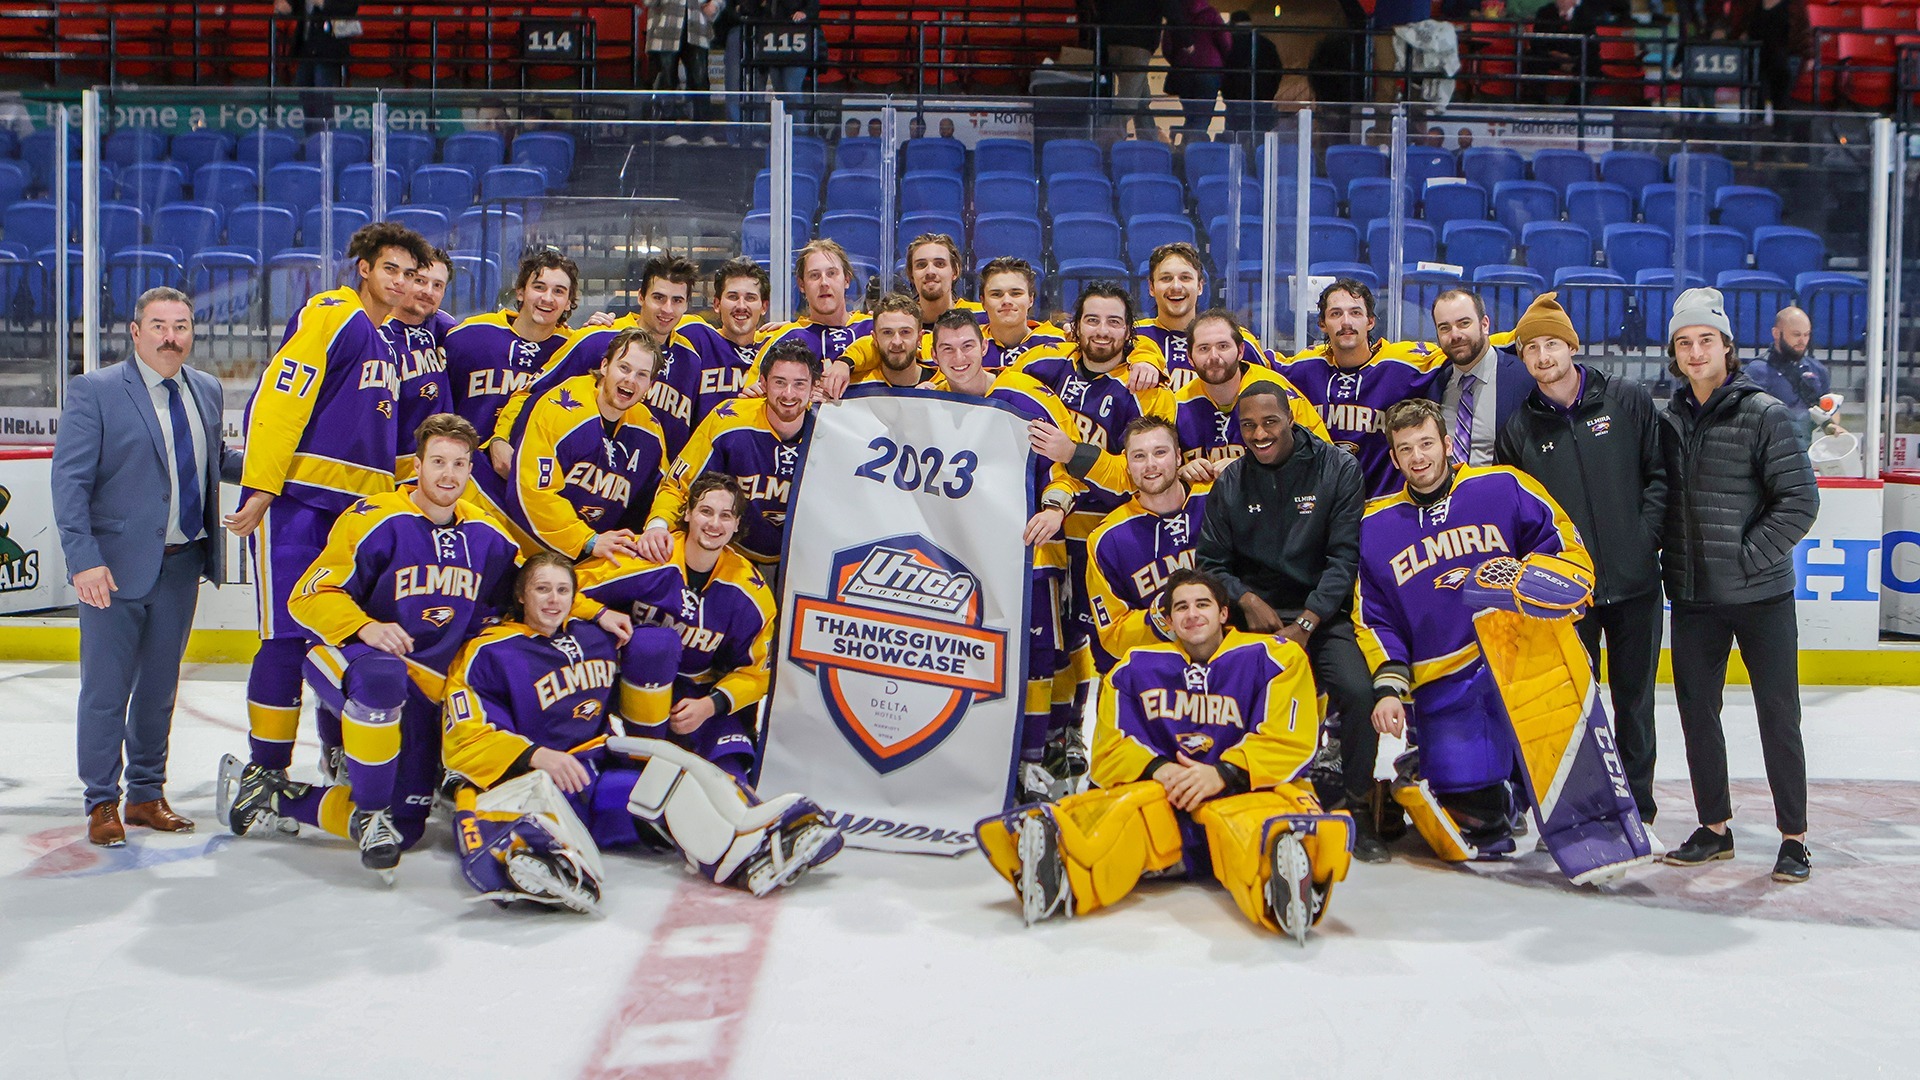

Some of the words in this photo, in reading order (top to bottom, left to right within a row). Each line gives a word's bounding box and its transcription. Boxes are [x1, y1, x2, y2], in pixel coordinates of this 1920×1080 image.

[527, 31, 572, 51] 114
[763, 32, 806, 52] 115
[1694, 54, 1738, 74] 115
[219, 103, 305, 128] Foste
[274, 357, 320, 398] 27
[467, 368, 533, 398] ELM
[641, 380, 692, 428] MIRA
[1099, 394, 1113, 418] C
[537, 456, 555, 490] 8
[626, 448, 640, 473] A
[854, 436, 979, 500] 2023
[736, 473, 792, 504] ELM
[1389, 523, 1511, 587] ELMIRA
[860, 550, 972, 601] UTICA
[855, 585, 952, 608] PIONEERS
[1090, 595, 1113, 629] 6
[815, 615, 985, 661] THANKSGIVING
[832, 638, 966, 675] SHOWCASE
[870, 698, 908, 714] DELTA
[874, 711, 902, 721] HOTELS
[1139, 687, 1244, 729] ELMIRA
[1288, 697, 1298, 733] 1
[1594, 725, 1631, 798] CCM
[405, 794, 434, 806] CC
[460, 817, 484, 855] CM
[825, 809, 975, 845] MPIONS
